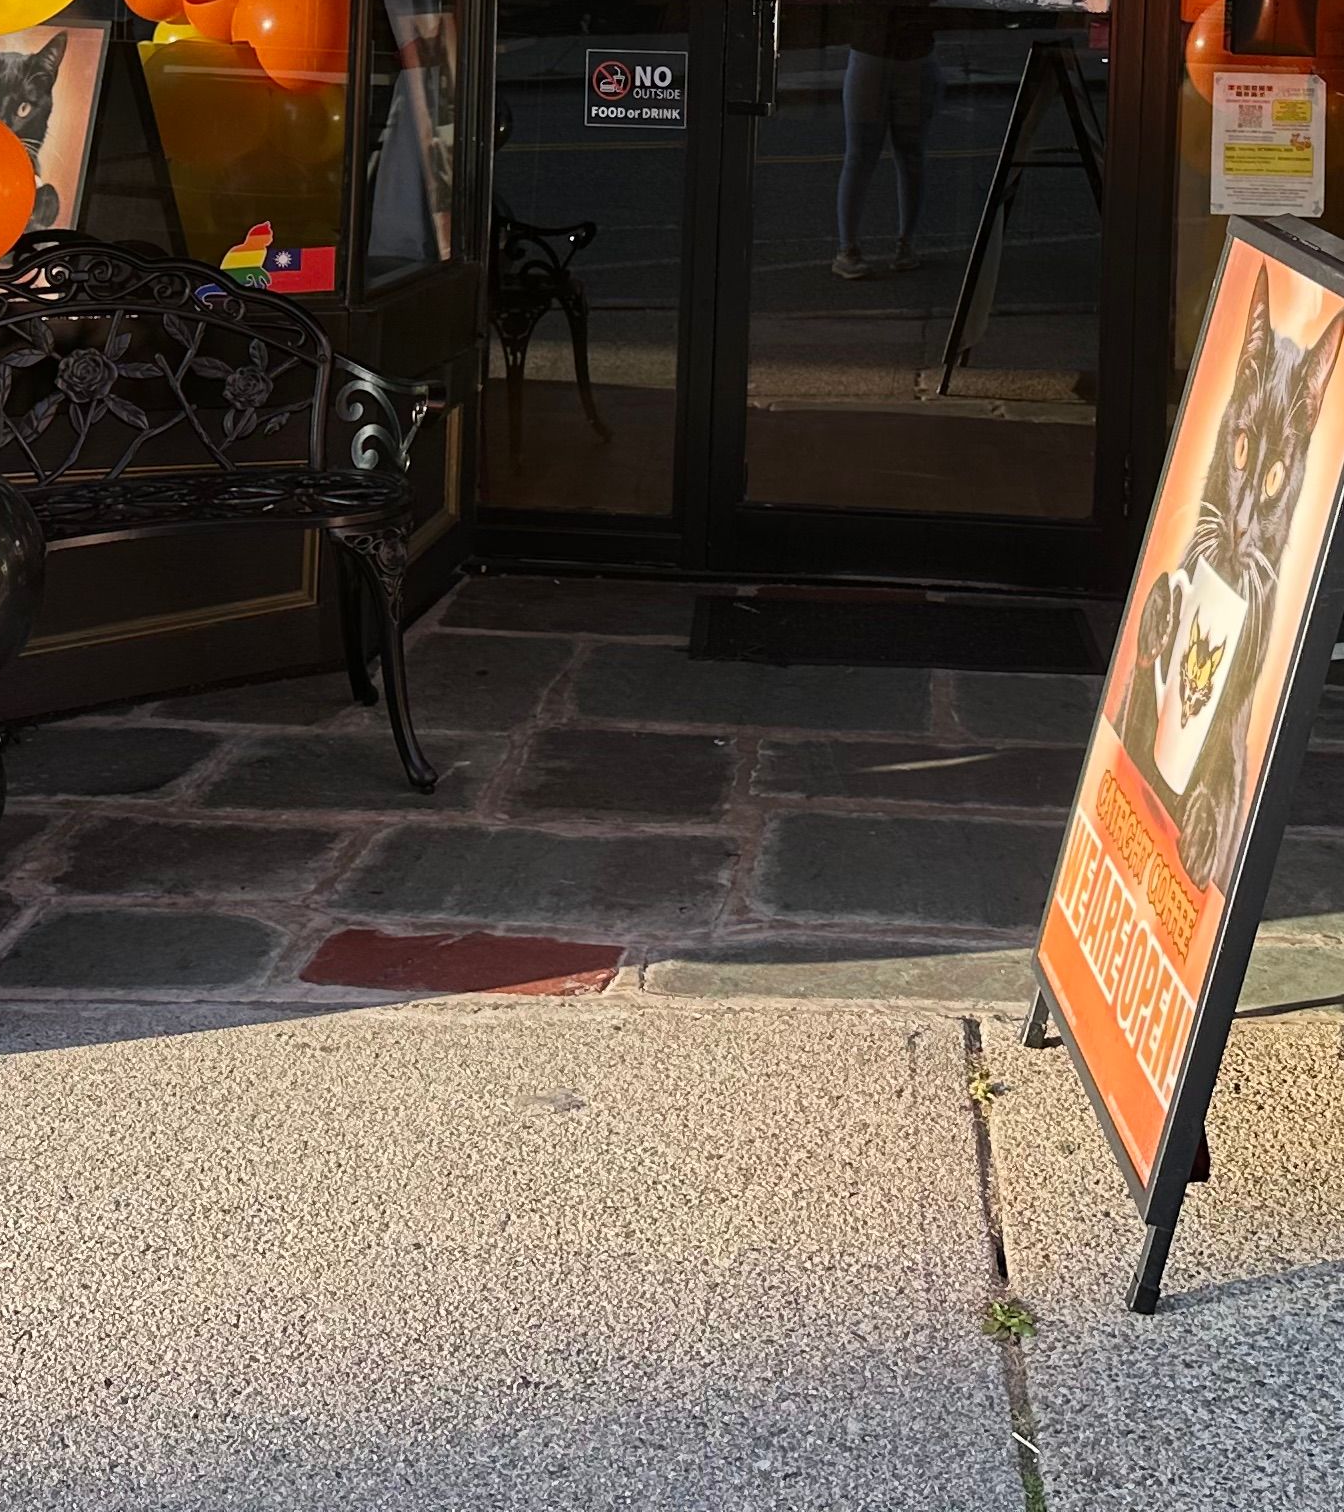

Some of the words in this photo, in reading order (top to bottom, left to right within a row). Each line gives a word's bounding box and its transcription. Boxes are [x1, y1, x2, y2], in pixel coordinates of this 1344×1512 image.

[634, 65, 673, 88] NO
[632, 88, 681, 100] OUTSIDE
[591, 106, 626, 118] FOOD
[626, 108, 641, 119] or
[642, 108, 681, 120] DRINK
[1055, 807, 1103, 939] WE
[1079, 854, 1137, 1007] ARE
[1115, 918, 1198, 1113] OPEN!
